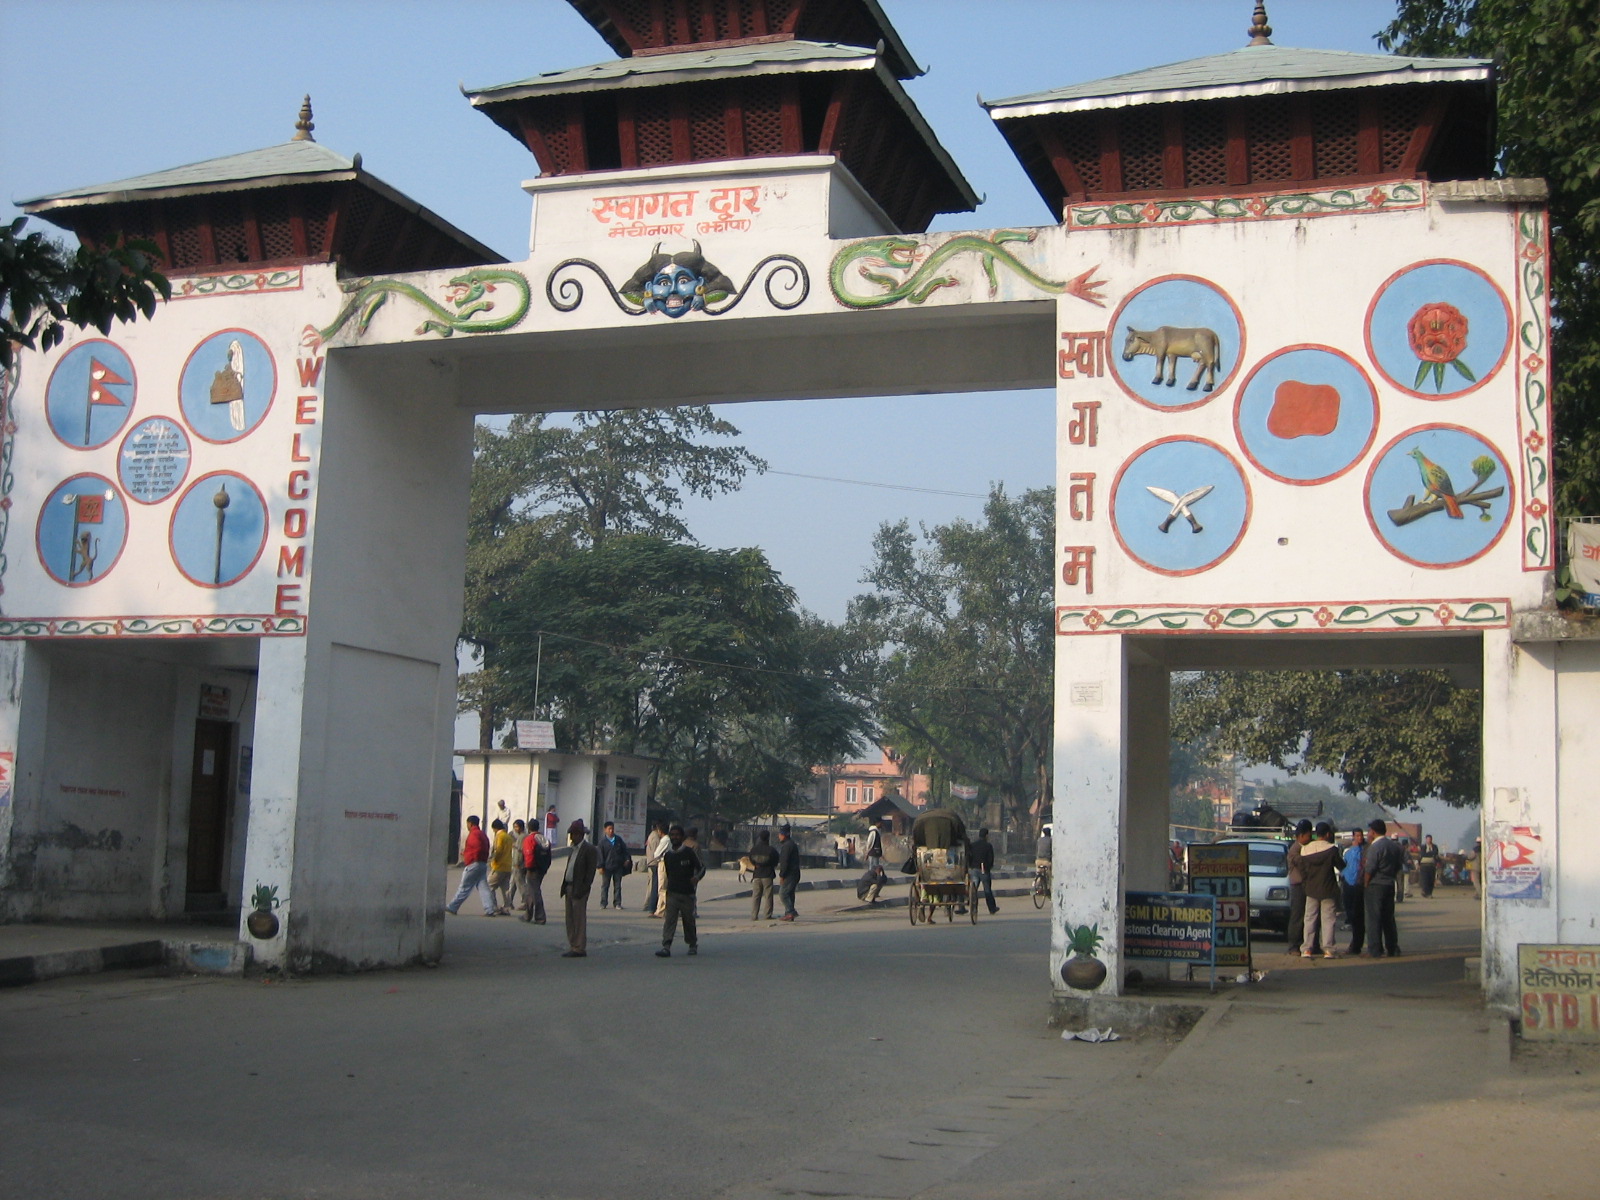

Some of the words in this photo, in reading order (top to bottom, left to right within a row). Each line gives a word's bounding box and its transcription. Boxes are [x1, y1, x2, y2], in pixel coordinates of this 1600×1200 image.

[591, 190, 700, 223] स्वागत
[274, 356, 325, 615] WELCOME
[1193, 878, 1242, 896] STD
[1125, 905, 1149, 920] EGMI
[1170, 908, 1212, 923] TRADERS
[1216, 903, 1240, 921] SD
[1124, 924, 1151, 936] stoms
[1152, 924, 1185, 940] Clearing
[1186, 925, 1212, 940] Agent
[1216, 929, 1244, 946] CAL
[1523, 967, 1594, 989] टेलिफोन
[1523, 992, 1580, 1030] STD
